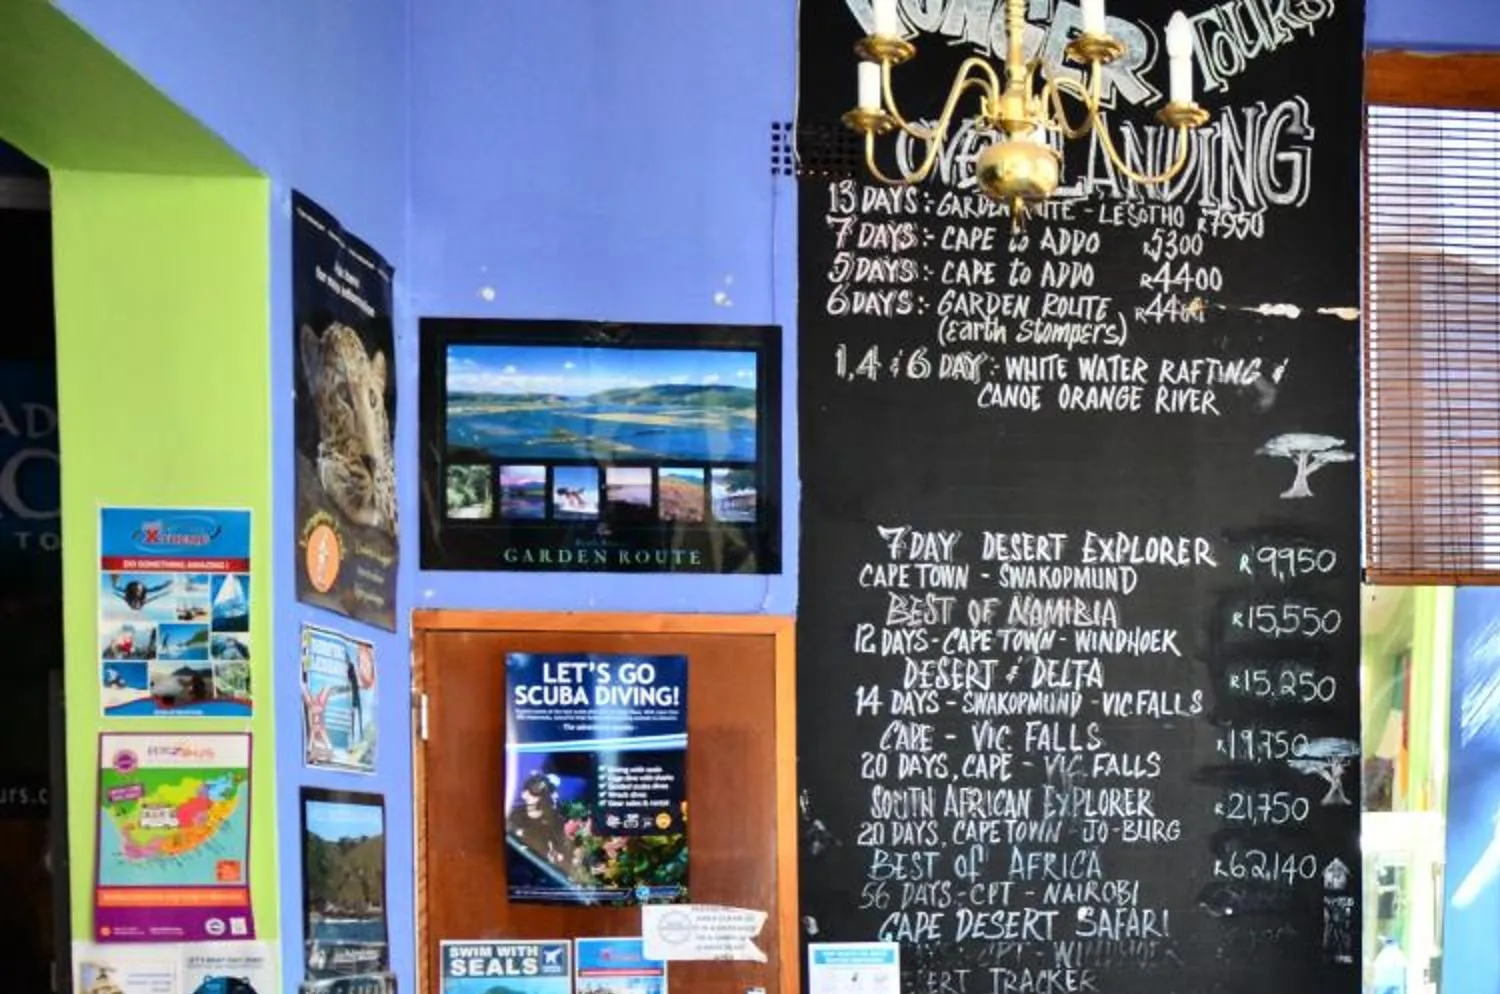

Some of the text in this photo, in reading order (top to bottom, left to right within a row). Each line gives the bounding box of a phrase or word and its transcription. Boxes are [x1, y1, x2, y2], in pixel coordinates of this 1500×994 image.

[897, 97, 1314, 211] OVELANDING
[828, 179, 856, 214] 13
[1100, 203, 1184, 227] LESOTHO
[1198, 208, 1264, 240] R7950
[826, 215, 857, 249] 7
[941, 226, 997, 251] CAPE
[1040, 226, 1100, 256] ADDO
[1143, 228, 1203, 262] R5300
[828, 252, 854, 283] 5
[941, 260, 996, 286] CAPE
[1008, 257, 1031, 287] to
[1041, 260, 1095, 288] ADDO
[1140, 261, 1223, 294] R4400
[826, 283, 851, 315] 6
[937, 288, 1030, 320] GARDEN
[1041, 294, 1112, 321] ROUTE
[906, 346, 932, 381] 6
[1005, 353, 1067, 382] WHITE
[1079, 354, 1148, 384] WATER
[1159, 357, 1262, 385] RAFTING
[977, 384, 1221, 416] CANOE ORANGE RIVER
[504, 548, 701, 566] GARDEN ROUTE
[876, 525, 907, 559] 7
[909, 531, 958, 563] DAY
[981, 530, 1068, 562] DESERT
[1082, 530, 1218, 567] EXPLORER
[859, 564, 909, 588] CAPE
[915, 564, 969, 590] TOWN
[999, 563, 1137, 595] SWAKOPMUND
[885, 591, 956, 626] BEST
[968, 597, 1001, 625] OF
[1008, 592, 1118, 628] NAMIBIA
[855, 624, 876, 653] 12
[1000, 629, 1056, 654] TOWN
[1074, 628, 1182, 657] WINDHOEK
[543, 662, 655, 684] LET'S GO
[903, 657, 999, 692] DESERT
[1031, 657, 1104, 690] DELTA
[515, 686, 679, 706] SCUBA DIVING!
[855, 685, 883, 717] 14
[890, 689, 940, 717] DAYS
[962, 691, 1083, 718] SWAKOPMUND
[880, 721, 933, 751] CAPE
[1025, 721, 1102, 752] FALLS
[861, 754, 887, 780] 20
[962, 754, 1012, 781] CAPE
[1092, 752, 1161, 779] FALLS
[871, 786, 934, 820] SOUTH
[944, 785, 1030, 820] AFRICAN
[1044, 785, 1154, 819] EXPLORER
[857, 820, 885, 846] 20
[954, 819, 999, 845] CAPE
[1004, 819, 1061, 844] TOWN
[867, 849, 940, 881] BEST
[1010, 847, 1103, 882] AFRICA
[859, 882, 889, 910] 56
[1043, 880, 1139, 904] NAIROBI
[879, 905, 1169, 942] CAPE DESERT SAFARI
[449, 945, 538, 958] SWIM WITH
[450, 958, 538, 976] SEALS
[989, 967, 1100, 994] TRACKER
